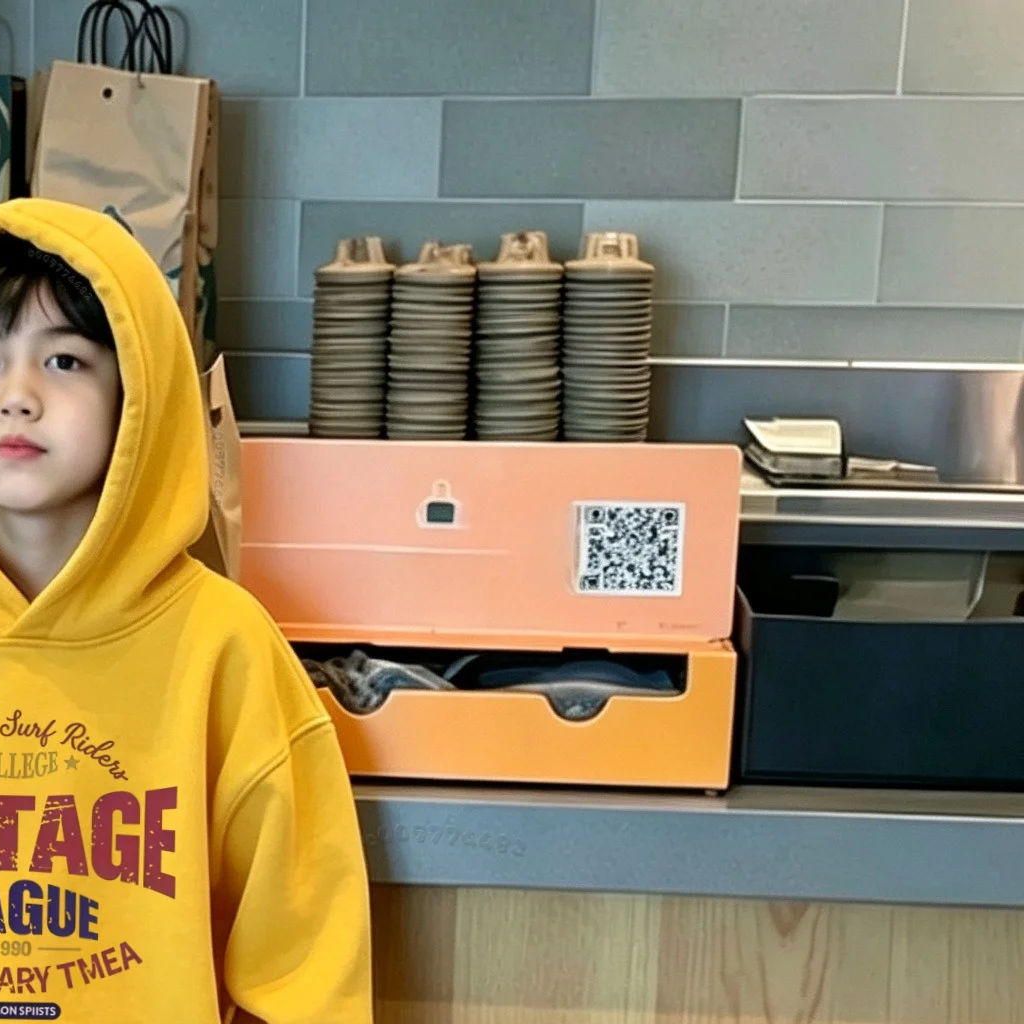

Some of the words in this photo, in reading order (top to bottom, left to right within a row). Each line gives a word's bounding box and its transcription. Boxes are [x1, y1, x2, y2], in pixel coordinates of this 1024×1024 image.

[0, 709, 56, 747] Surf
[60, 722, 129, 781] Riders
[56, 941, 143, 989] TMEA
